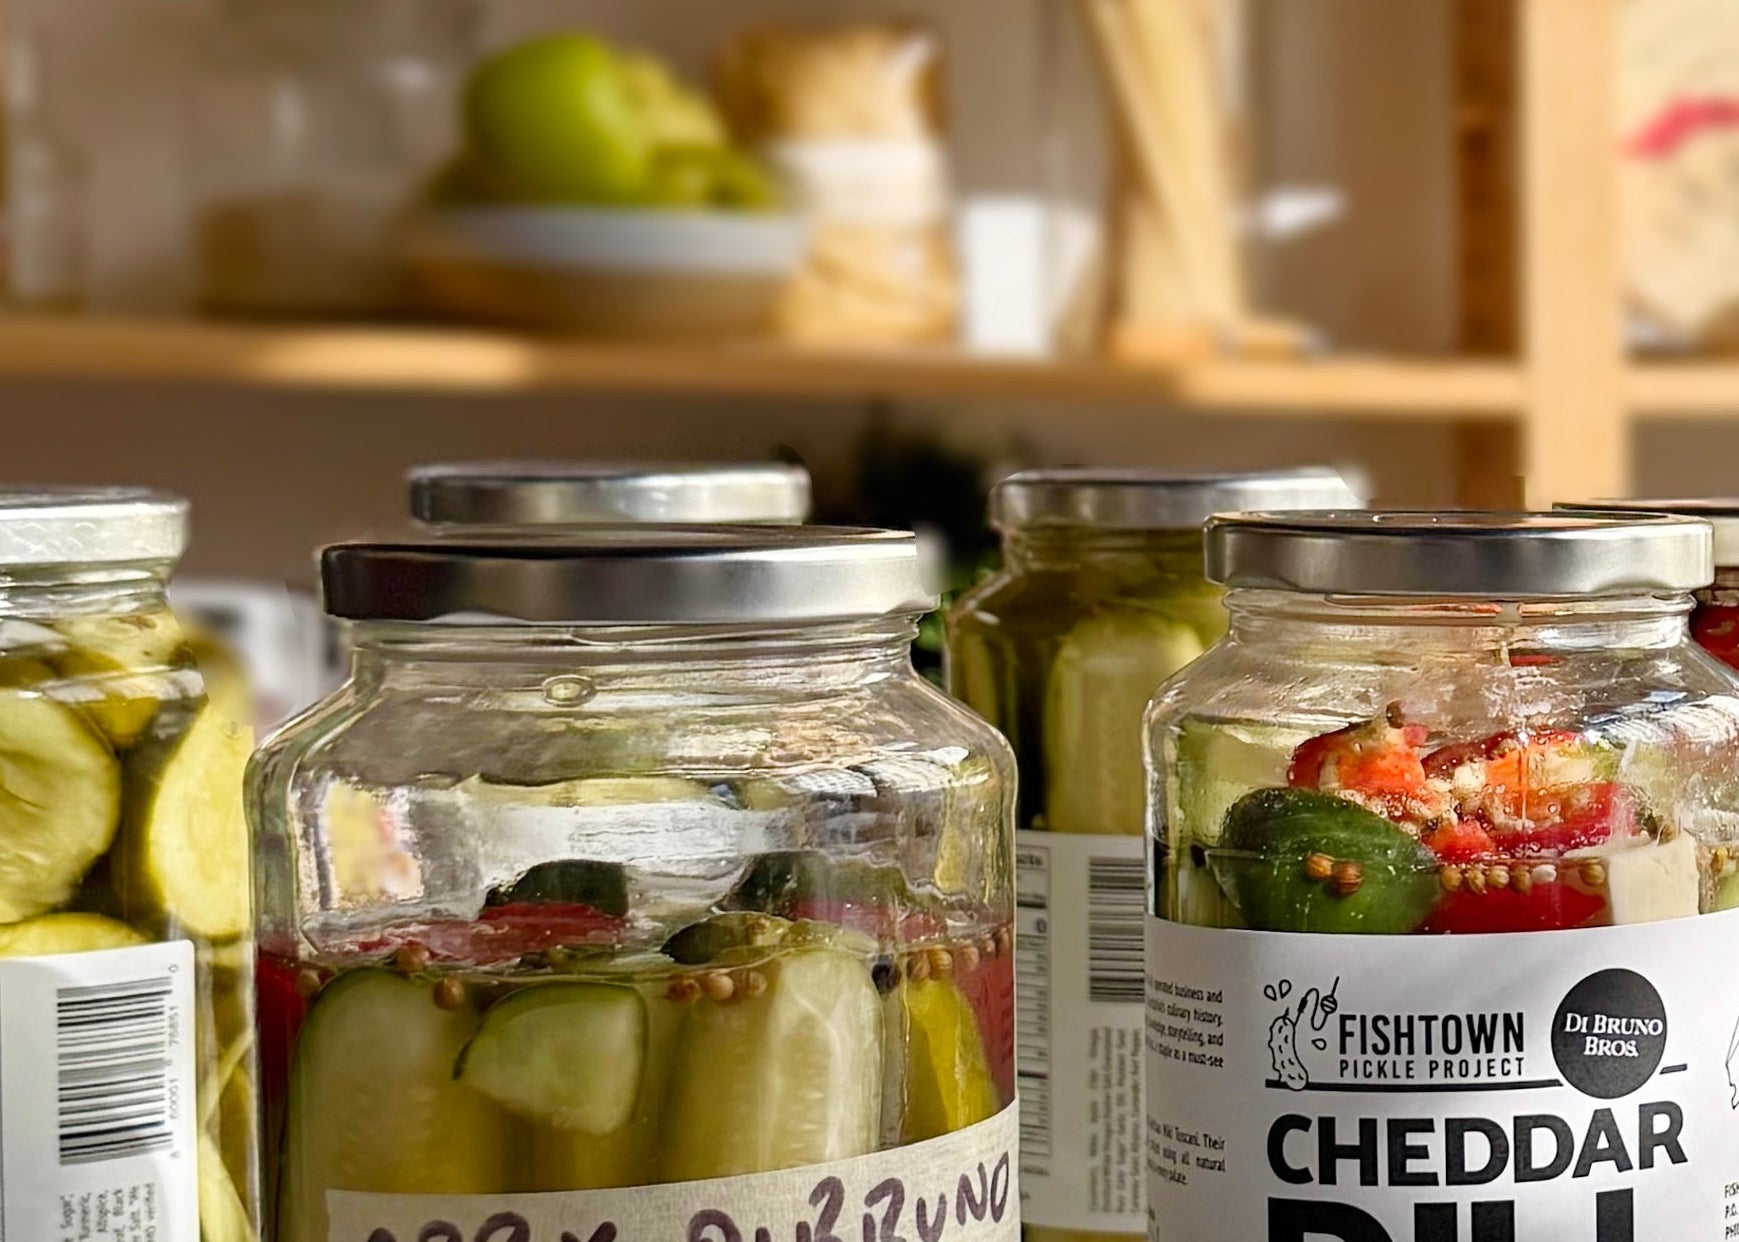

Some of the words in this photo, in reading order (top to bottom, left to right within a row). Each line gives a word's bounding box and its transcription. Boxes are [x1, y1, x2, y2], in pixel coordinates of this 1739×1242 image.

[1207, 990, 1223, 1003] and
[1207, 1033, 1224, 1047] and
[1339, 1012, 1525, 1056] FISHTOWN
[1584, 1036, 1639, 1057] BROS.
[1339, 1057, 1415, 1079] PICKLE
[1428, 1056, 1525, 1078] PROJECT
[1203, 1132, 1225, 1150] Their
[1267, 1100, 1689, 1187] CHEDDAR
[1196, 1156, 1226, 1172] natural
